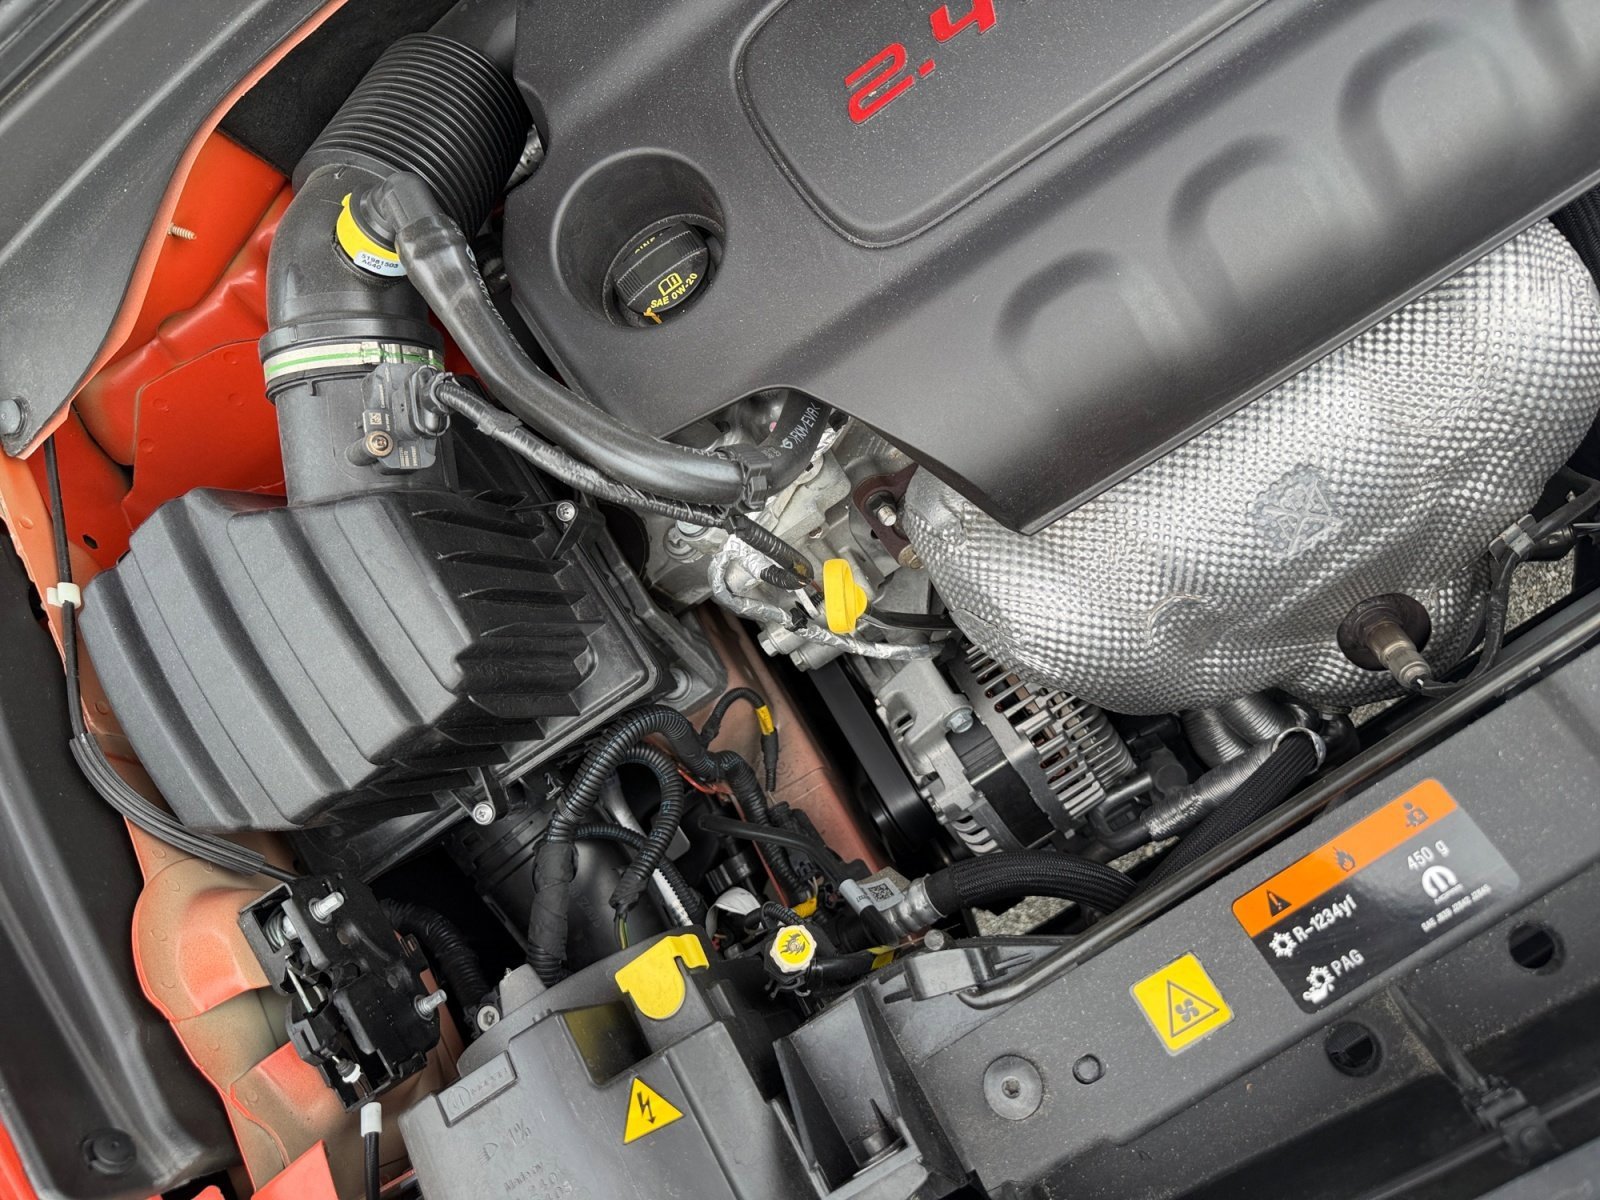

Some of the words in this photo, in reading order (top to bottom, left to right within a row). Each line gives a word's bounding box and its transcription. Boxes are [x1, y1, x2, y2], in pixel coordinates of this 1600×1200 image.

[844, 0, 997, 124] 2.4
[650, 296, 670, 309] SAE
[1407, 846, 1435, 870] 450
[1435, 839, 1450, 858] g
[1292, 893, 1357, 943] R-1234yf
[1330, 949, 1365, 977] PAG
